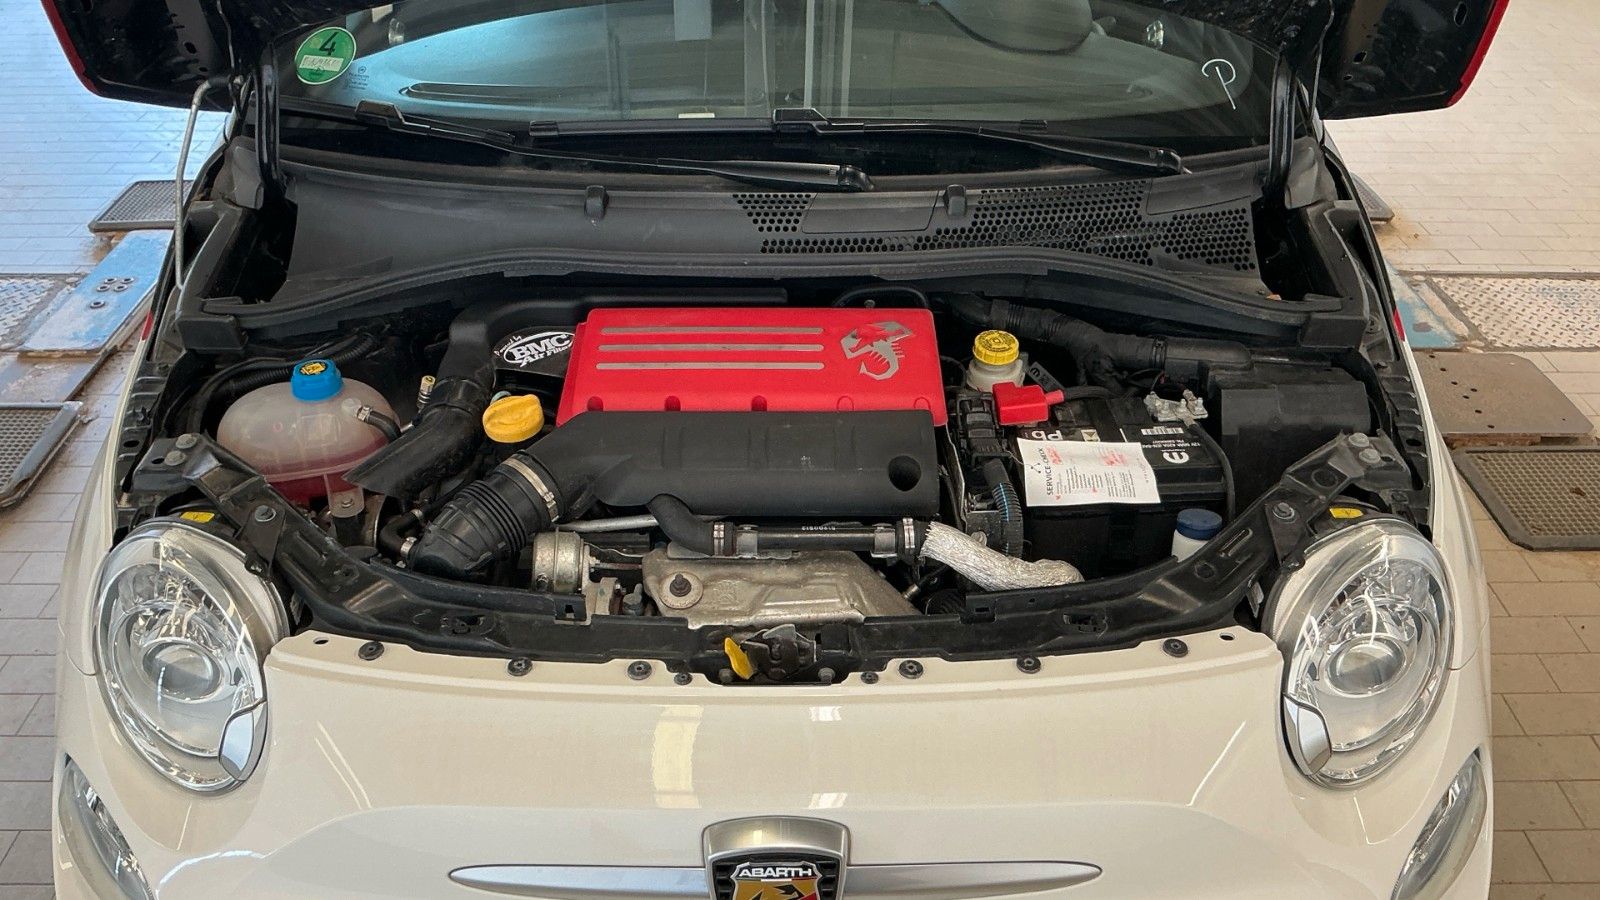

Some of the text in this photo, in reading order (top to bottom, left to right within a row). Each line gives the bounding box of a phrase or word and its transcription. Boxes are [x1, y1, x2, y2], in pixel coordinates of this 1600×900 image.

[319, 32, 339, 56] 4
[508, 334, 570, 361] BMC
[519, 352, 546, 368] Air
[1038, 447, 1054, 496] SERVICE-CHECK
[739, 867, 812, 878] ABARTH
